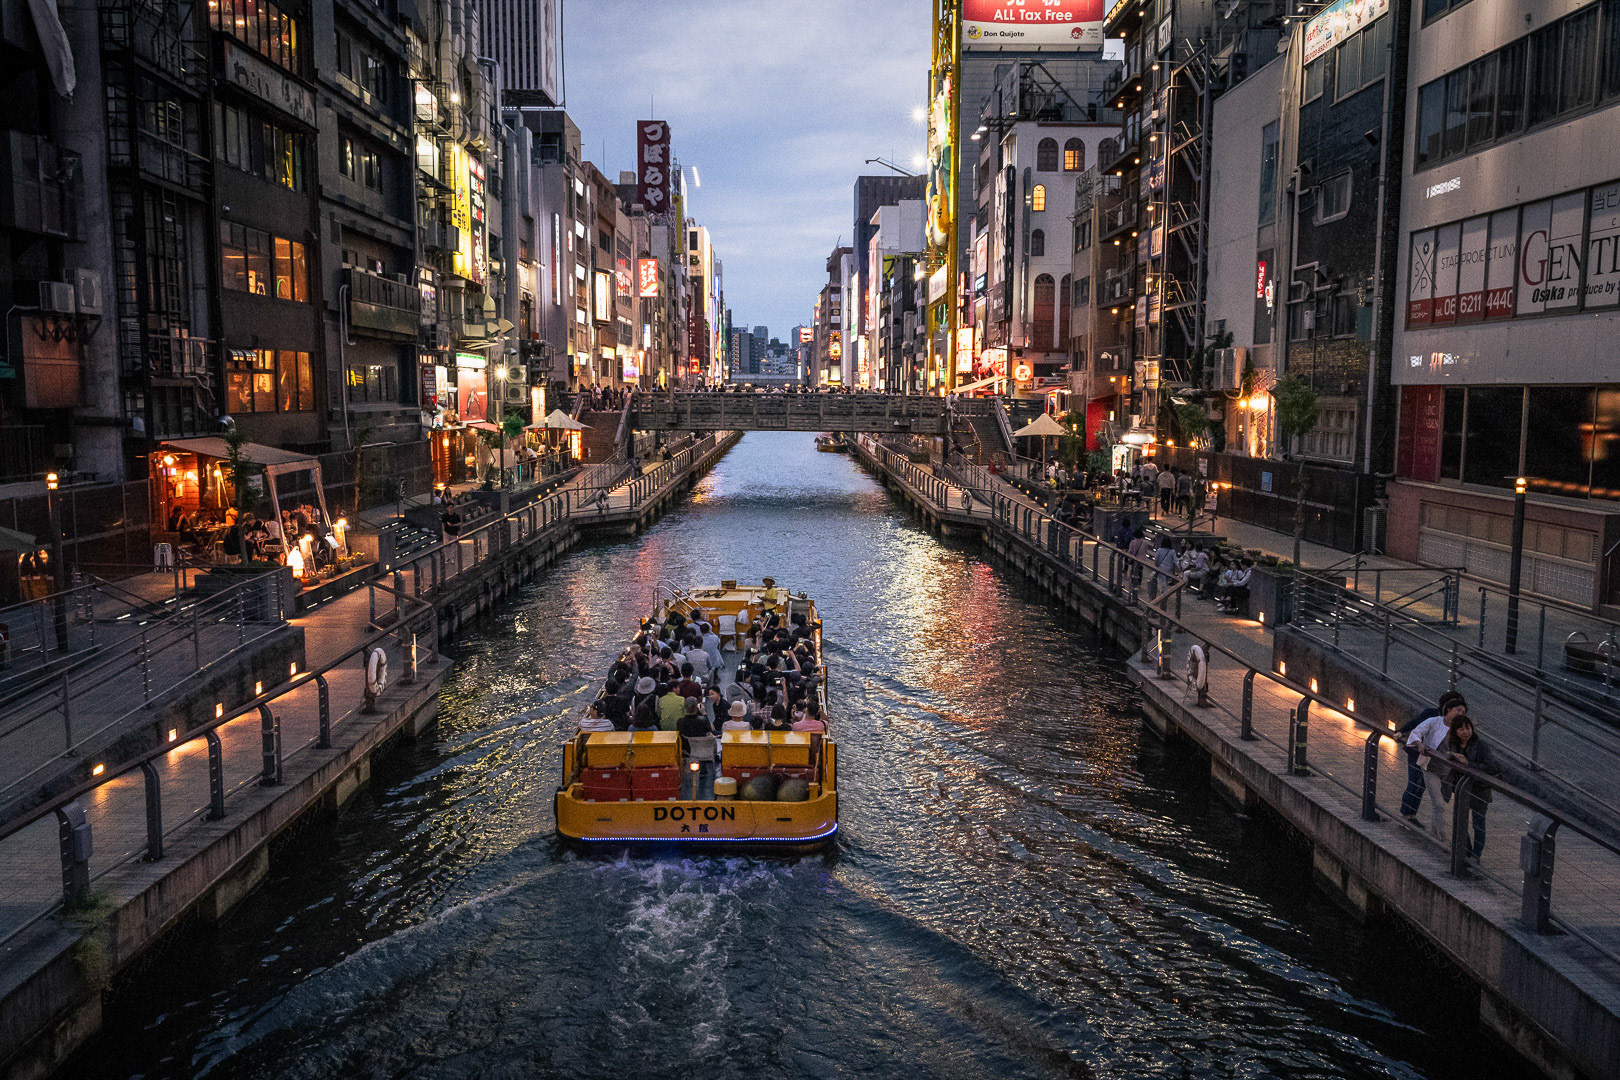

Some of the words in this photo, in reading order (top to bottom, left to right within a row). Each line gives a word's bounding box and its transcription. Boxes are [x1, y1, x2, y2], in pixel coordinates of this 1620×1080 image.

[993, 9, 1015, 21] ALL
[1019, 9, 1042, 21] Tax
[1045, 9, 1073, 21] Free
[999, 30, 1025, 38] Quijote
[643, 121, 666, 207] づぼらや
[1531, 285, 1565, 303] Osaka
[1604, 280, 1616, 295] by
[1443, 297, 1456, 316] 06
[1460, 294, 1482, 314] 6211
[653, 805, 736, 821] DOTON
[680, 823, 709, 833] 大阪
